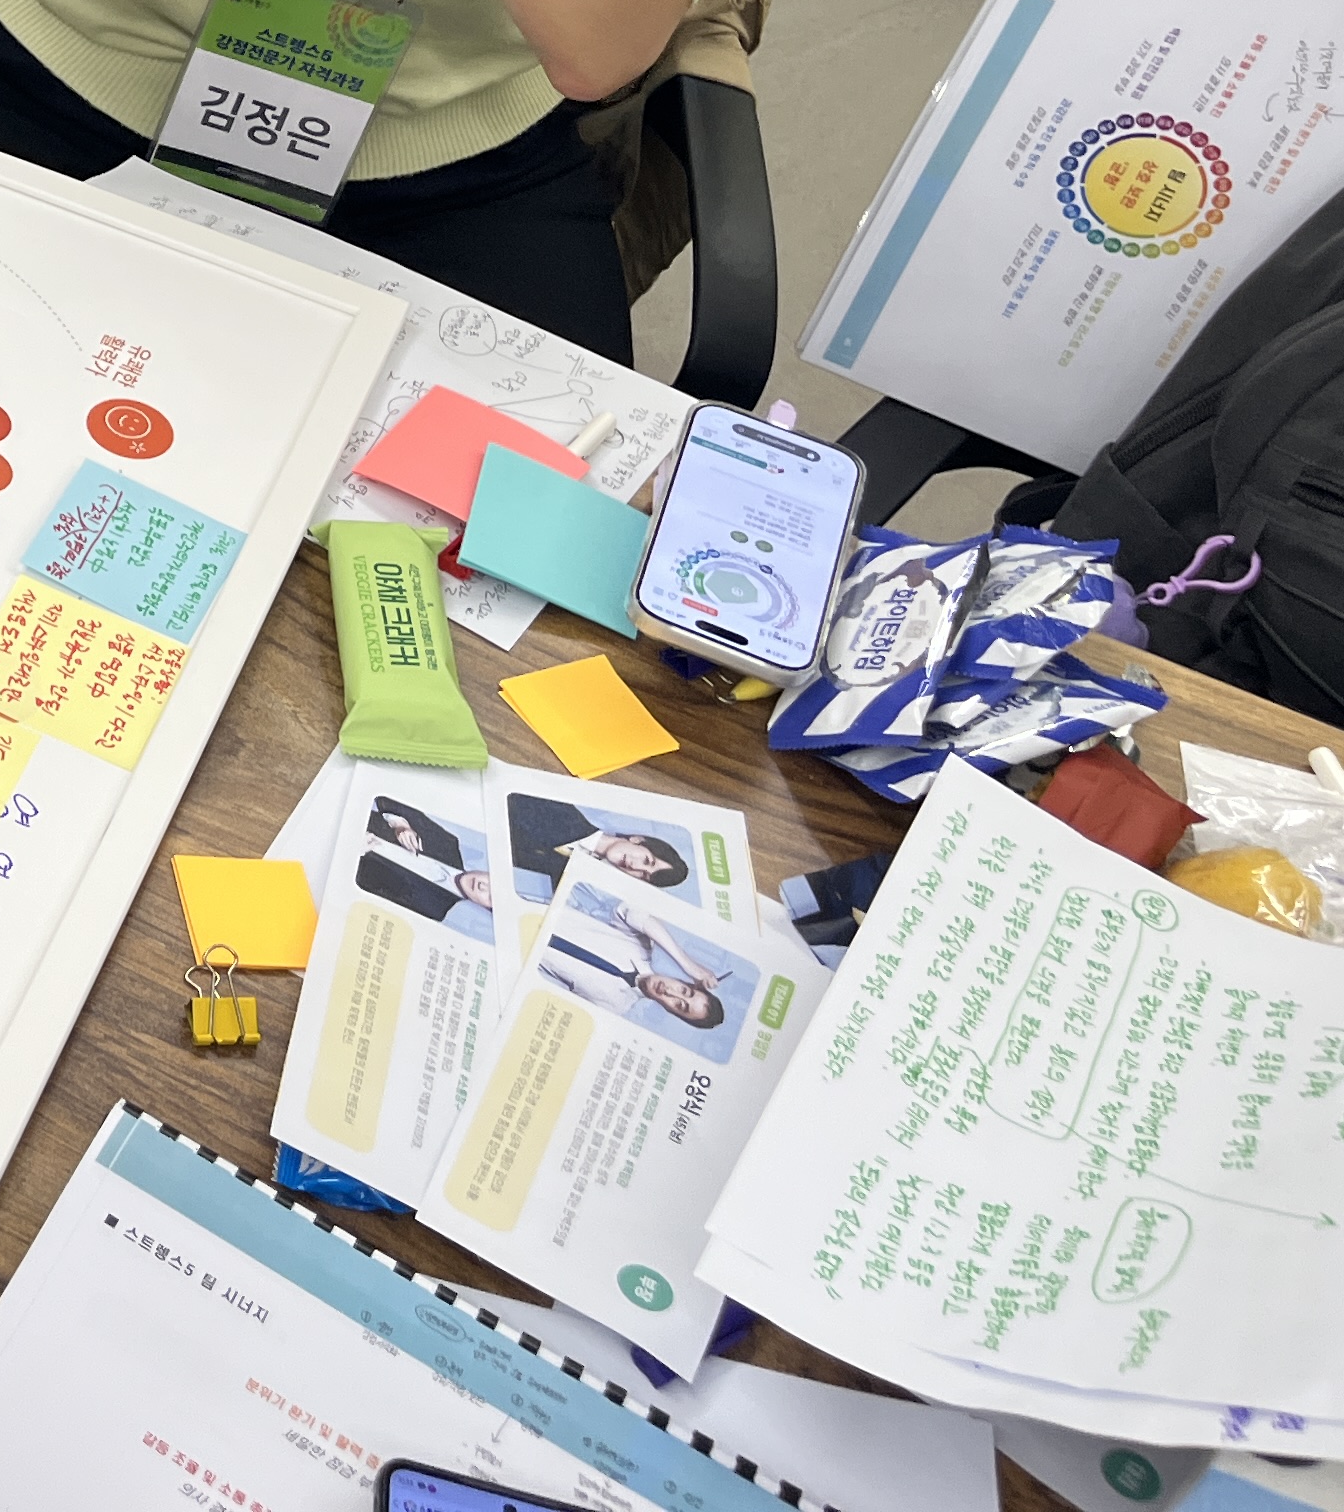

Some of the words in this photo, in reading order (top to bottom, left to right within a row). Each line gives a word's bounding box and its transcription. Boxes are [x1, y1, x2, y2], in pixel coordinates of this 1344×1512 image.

[215, 33, 296, 71] 강점전문가
[298, 60, 365, 93] 자격과정
[200, 84, 331, 161] 김정은
[1135, 160, 1159, 185] 상호
[1167, 168, 1187, 184] 팀
[1119, 184, 1145, 210] 보완
[1143, 183, 1176, 223] 시너지
[84, 334, 126, 378] 활력가
[111, 345, 152, 389] 유쾌한
[347, 553, 378, 602] VEGGIE
[107, 632, 136, 656] 상품
[354, 601, 390, 674] CRACKERS
[839, 583, 930, 671] 화이트하임
[94, 717, 127, 749] 다르고
[679, 1069, 712, 1117] 오상식
[122, 1227, 196, 1277] 스트렝스5
[200, 1272, 218, 1291] 팀
[221, 1286, 270, 1324] 시너지
[245, 1377, 287, 1411] 분위기
